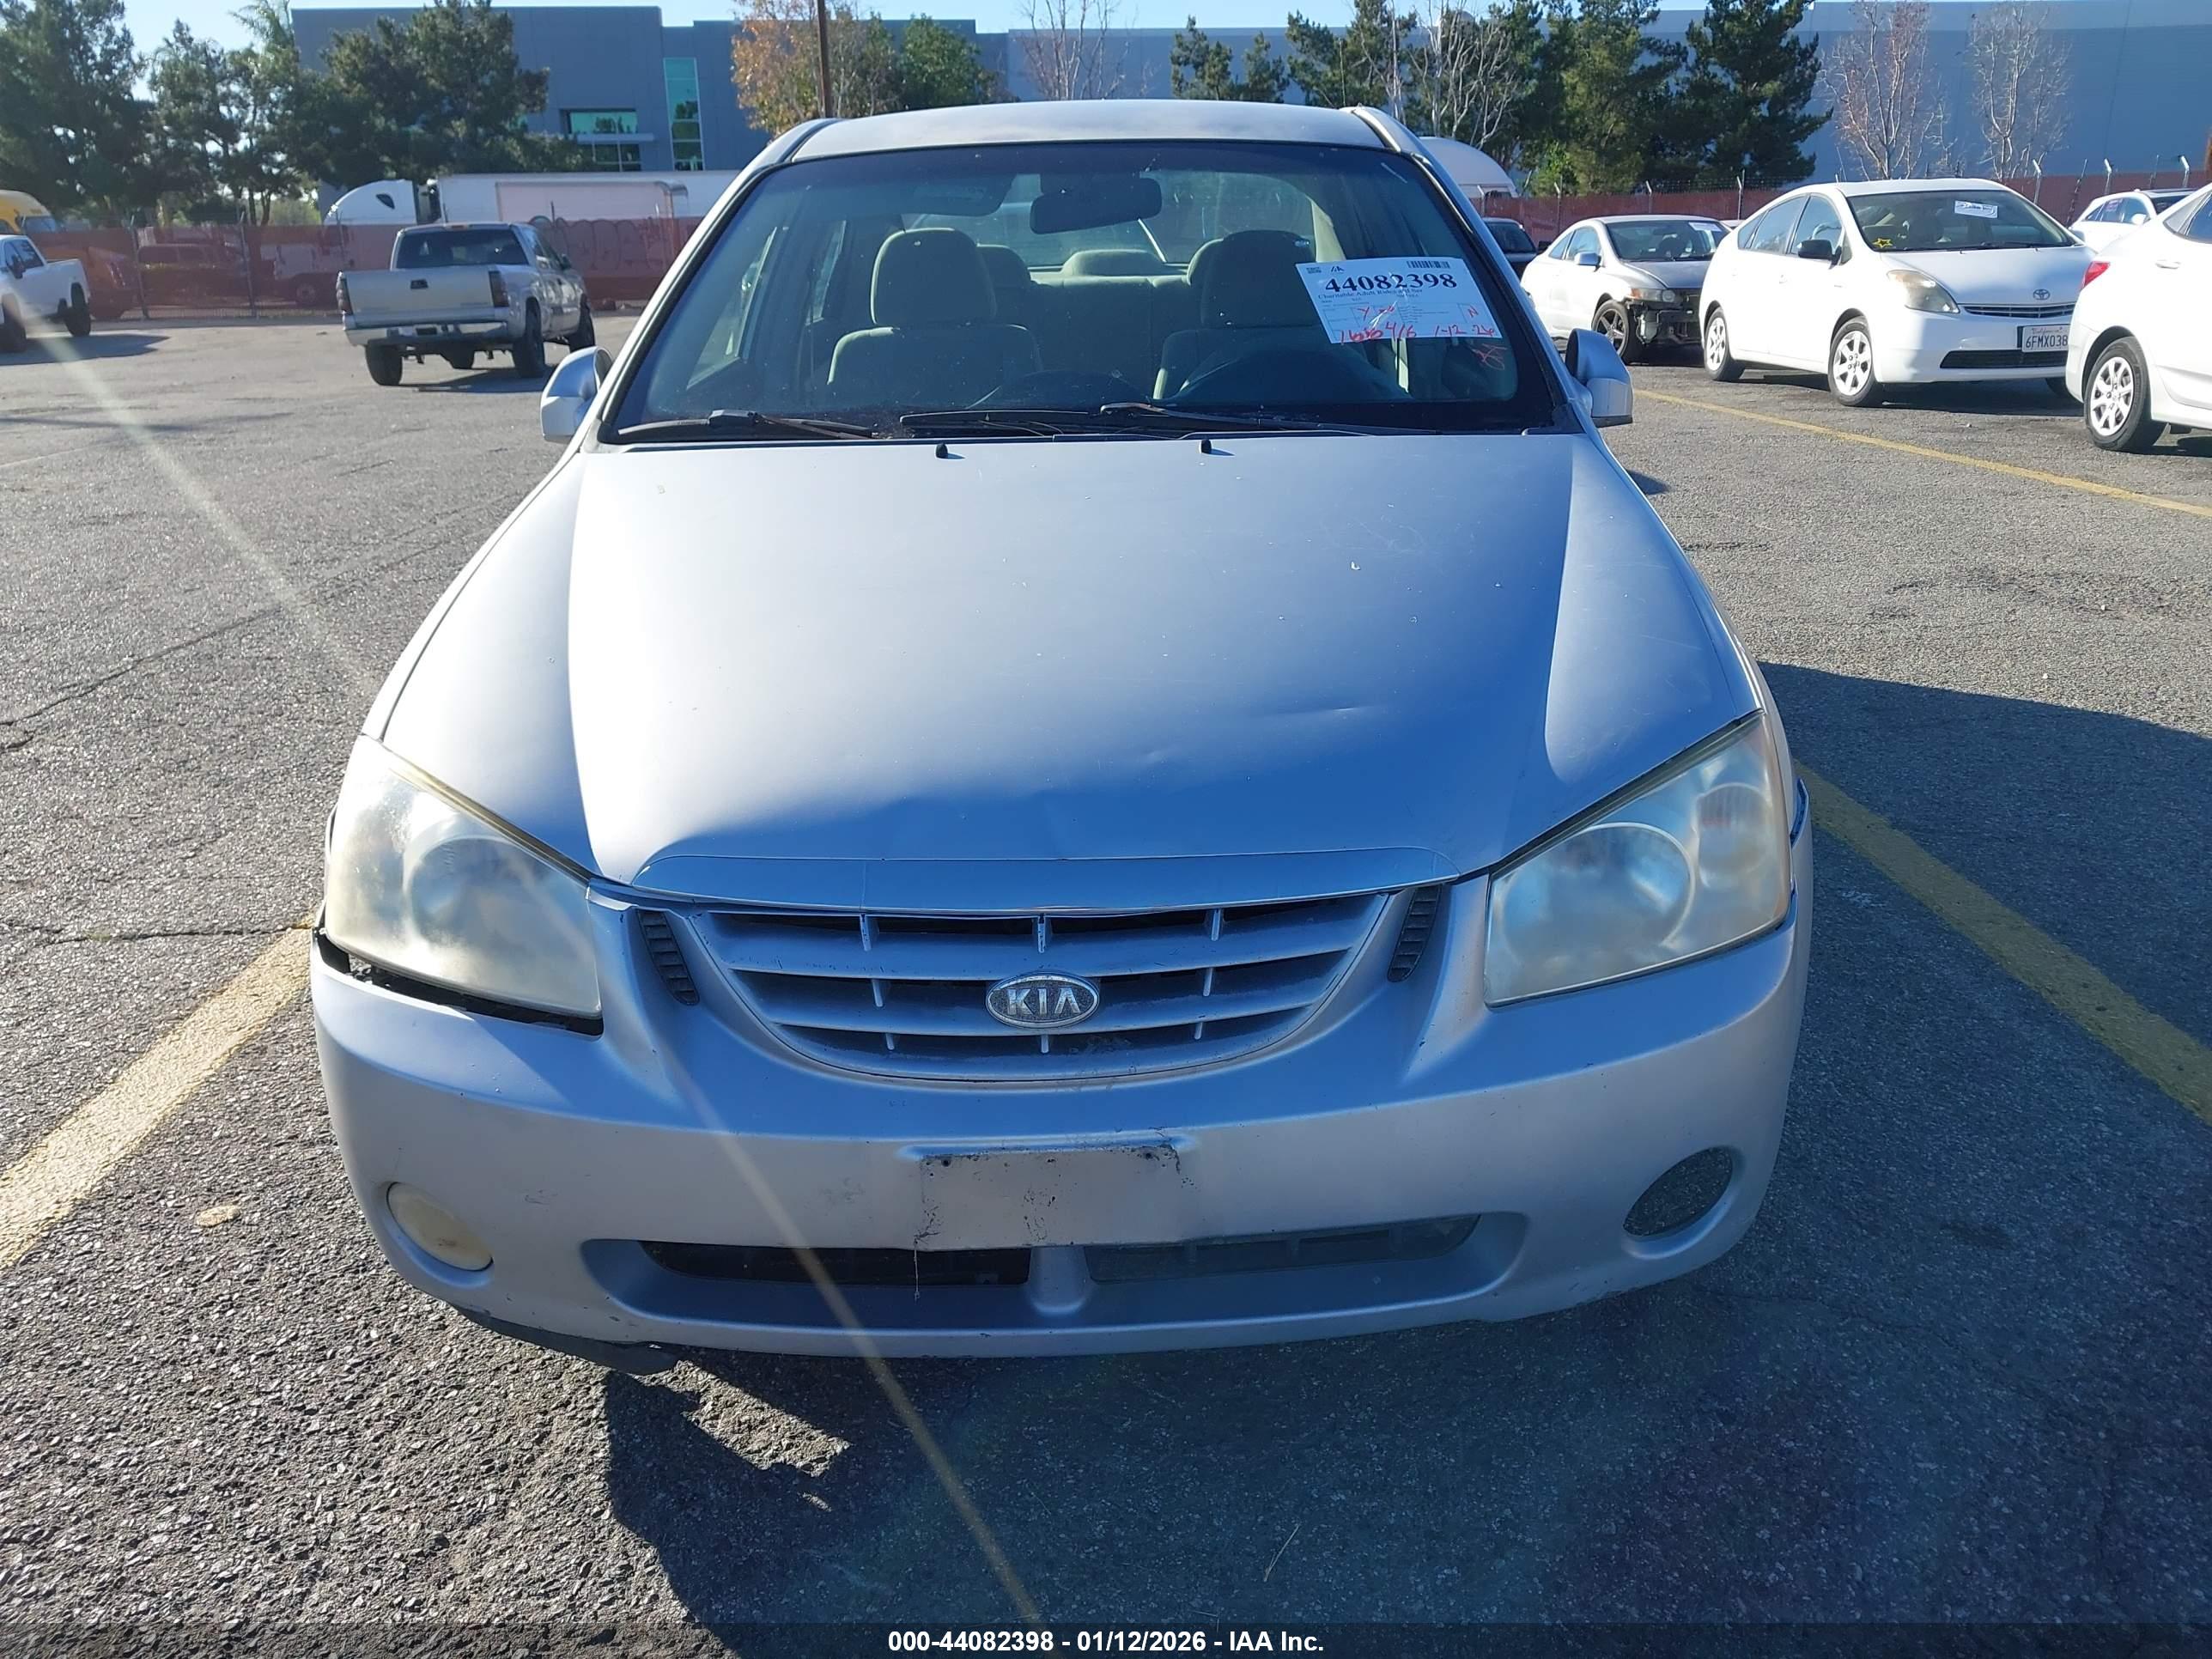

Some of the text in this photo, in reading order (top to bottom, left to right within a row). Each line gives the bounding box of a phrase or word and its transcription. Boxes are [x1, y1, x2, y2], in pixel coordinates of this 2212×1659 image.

[1325, 272, 1457, 293] 44082398
[2026, 335, 2069, 349] 6FMX038
[1006, 986, 1082, 1016] KIA
